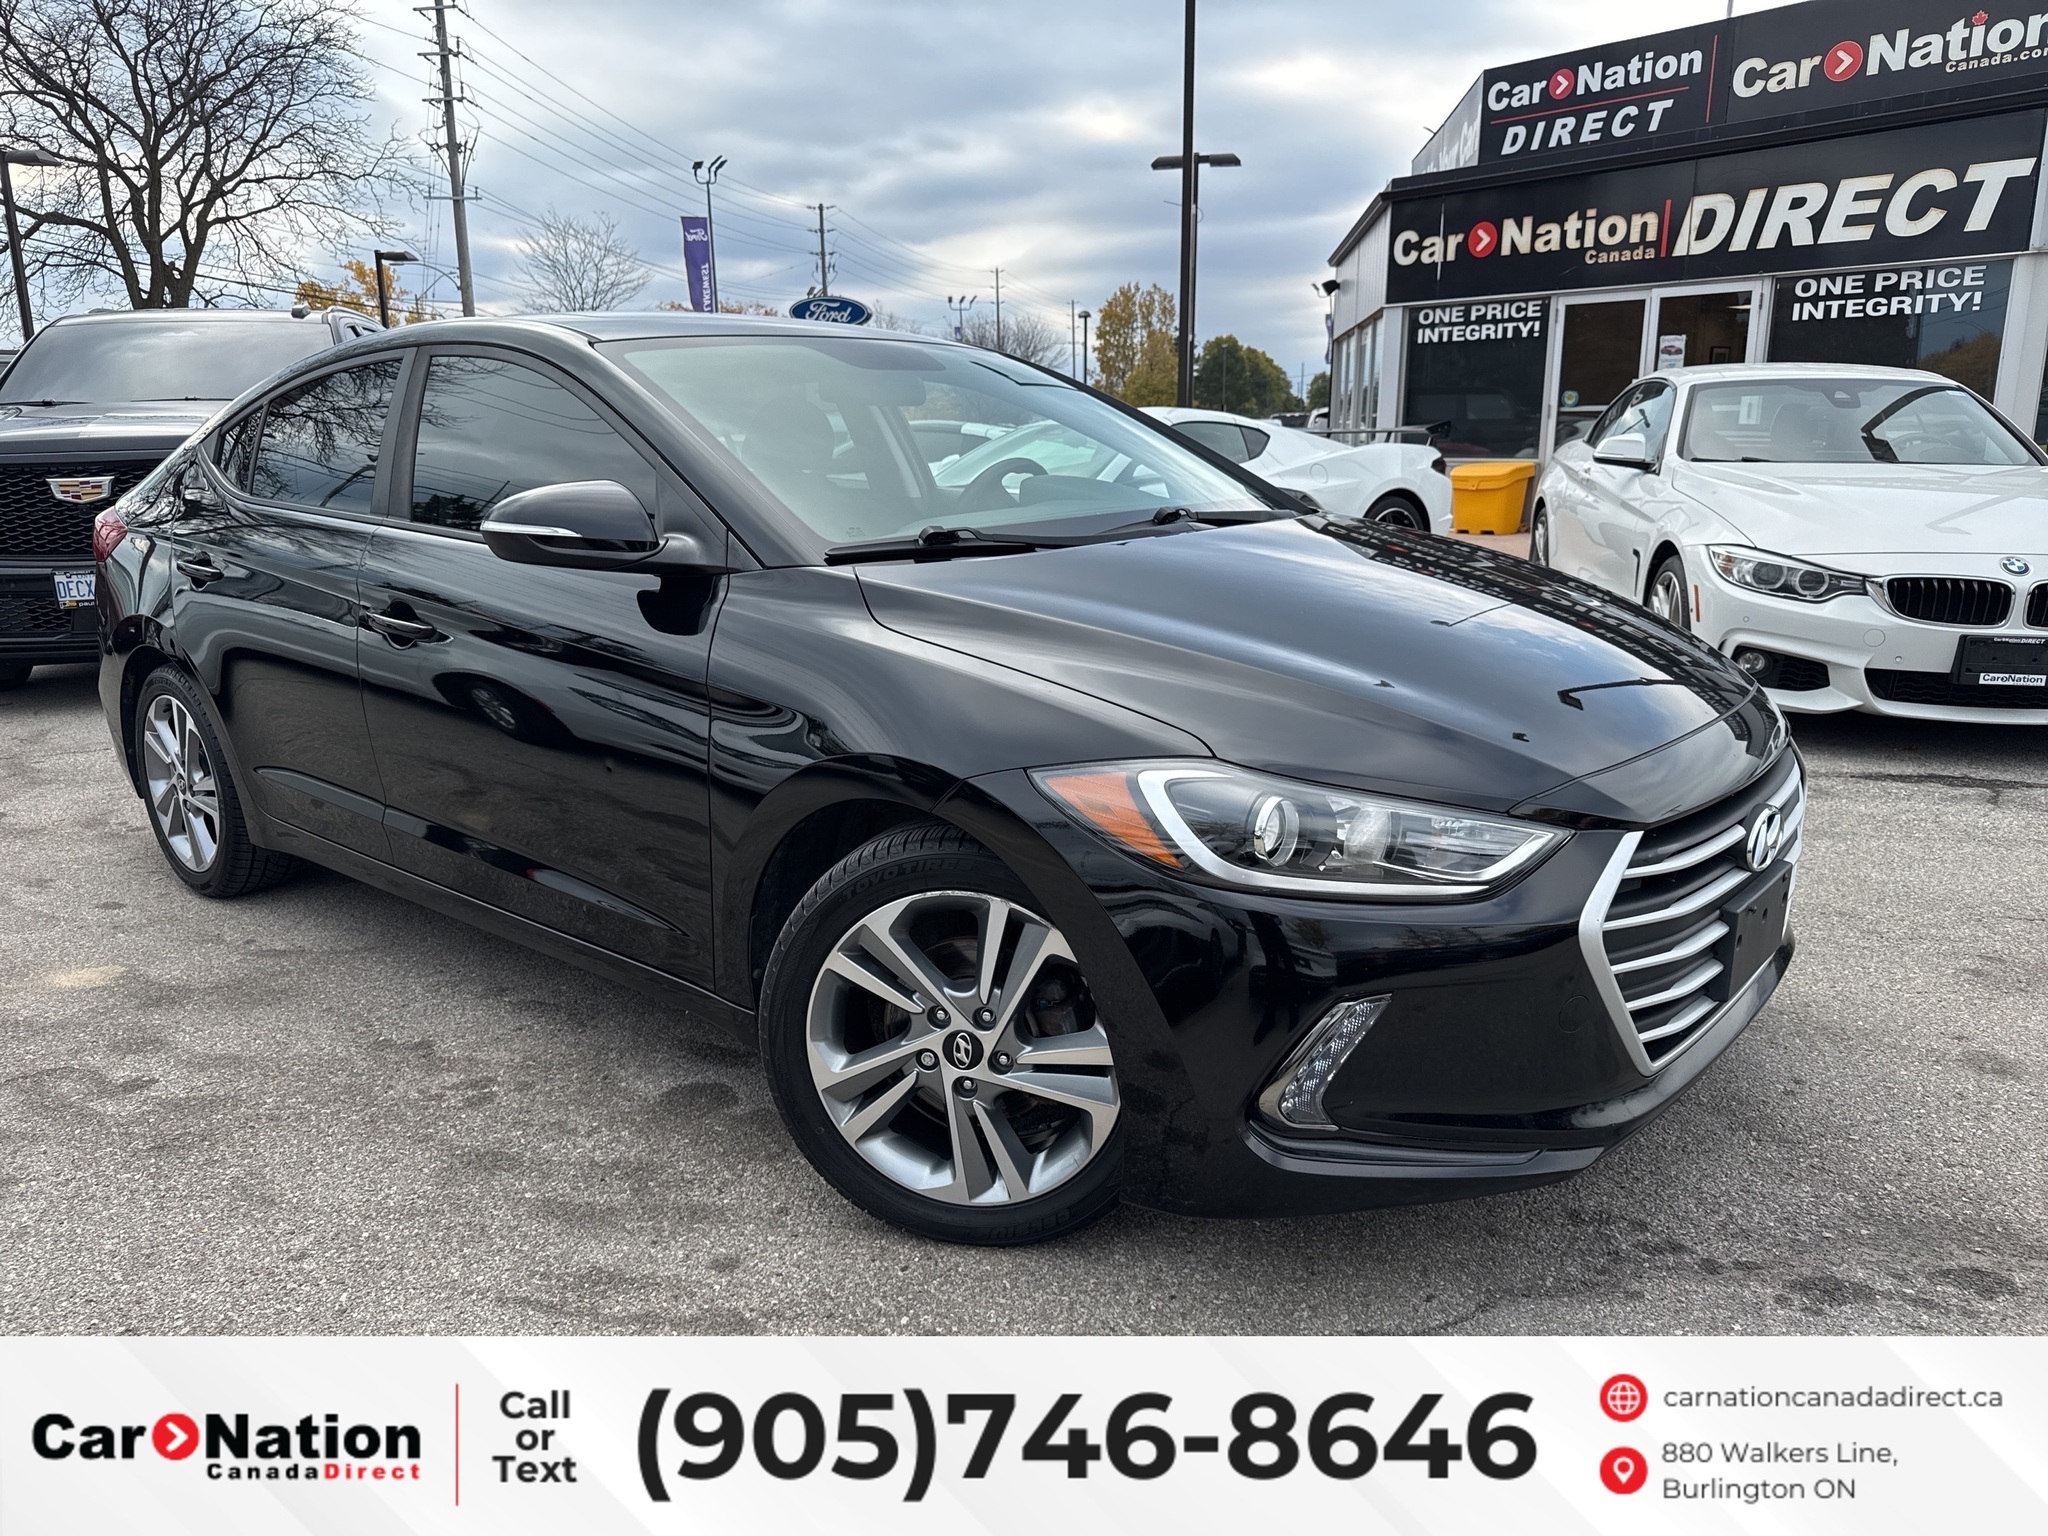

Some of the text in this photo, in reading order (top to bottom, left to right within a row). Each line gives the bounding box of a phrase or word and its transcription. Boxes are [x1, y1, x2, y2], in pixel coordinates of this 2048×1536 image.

[1487, 50, 1703, 111] Car Nation
[1733, 55, 1823, 98] Car
[1500, 98, 1675, 156] DIRECT
[1393, 156, 2038, 267] Car Nation DIRECT
[1584, 245, 1655, 265] Canada
[1794, 264, 1988, 298] ONE PRICE
[805, 300, 853, 323] Ford
[1418, 300, 1543, 325] ONE PRICE
[1791, 291, 1983, 322] INTEGRITY!
[1417, 320, 1541, 344] INTEGRITY!
